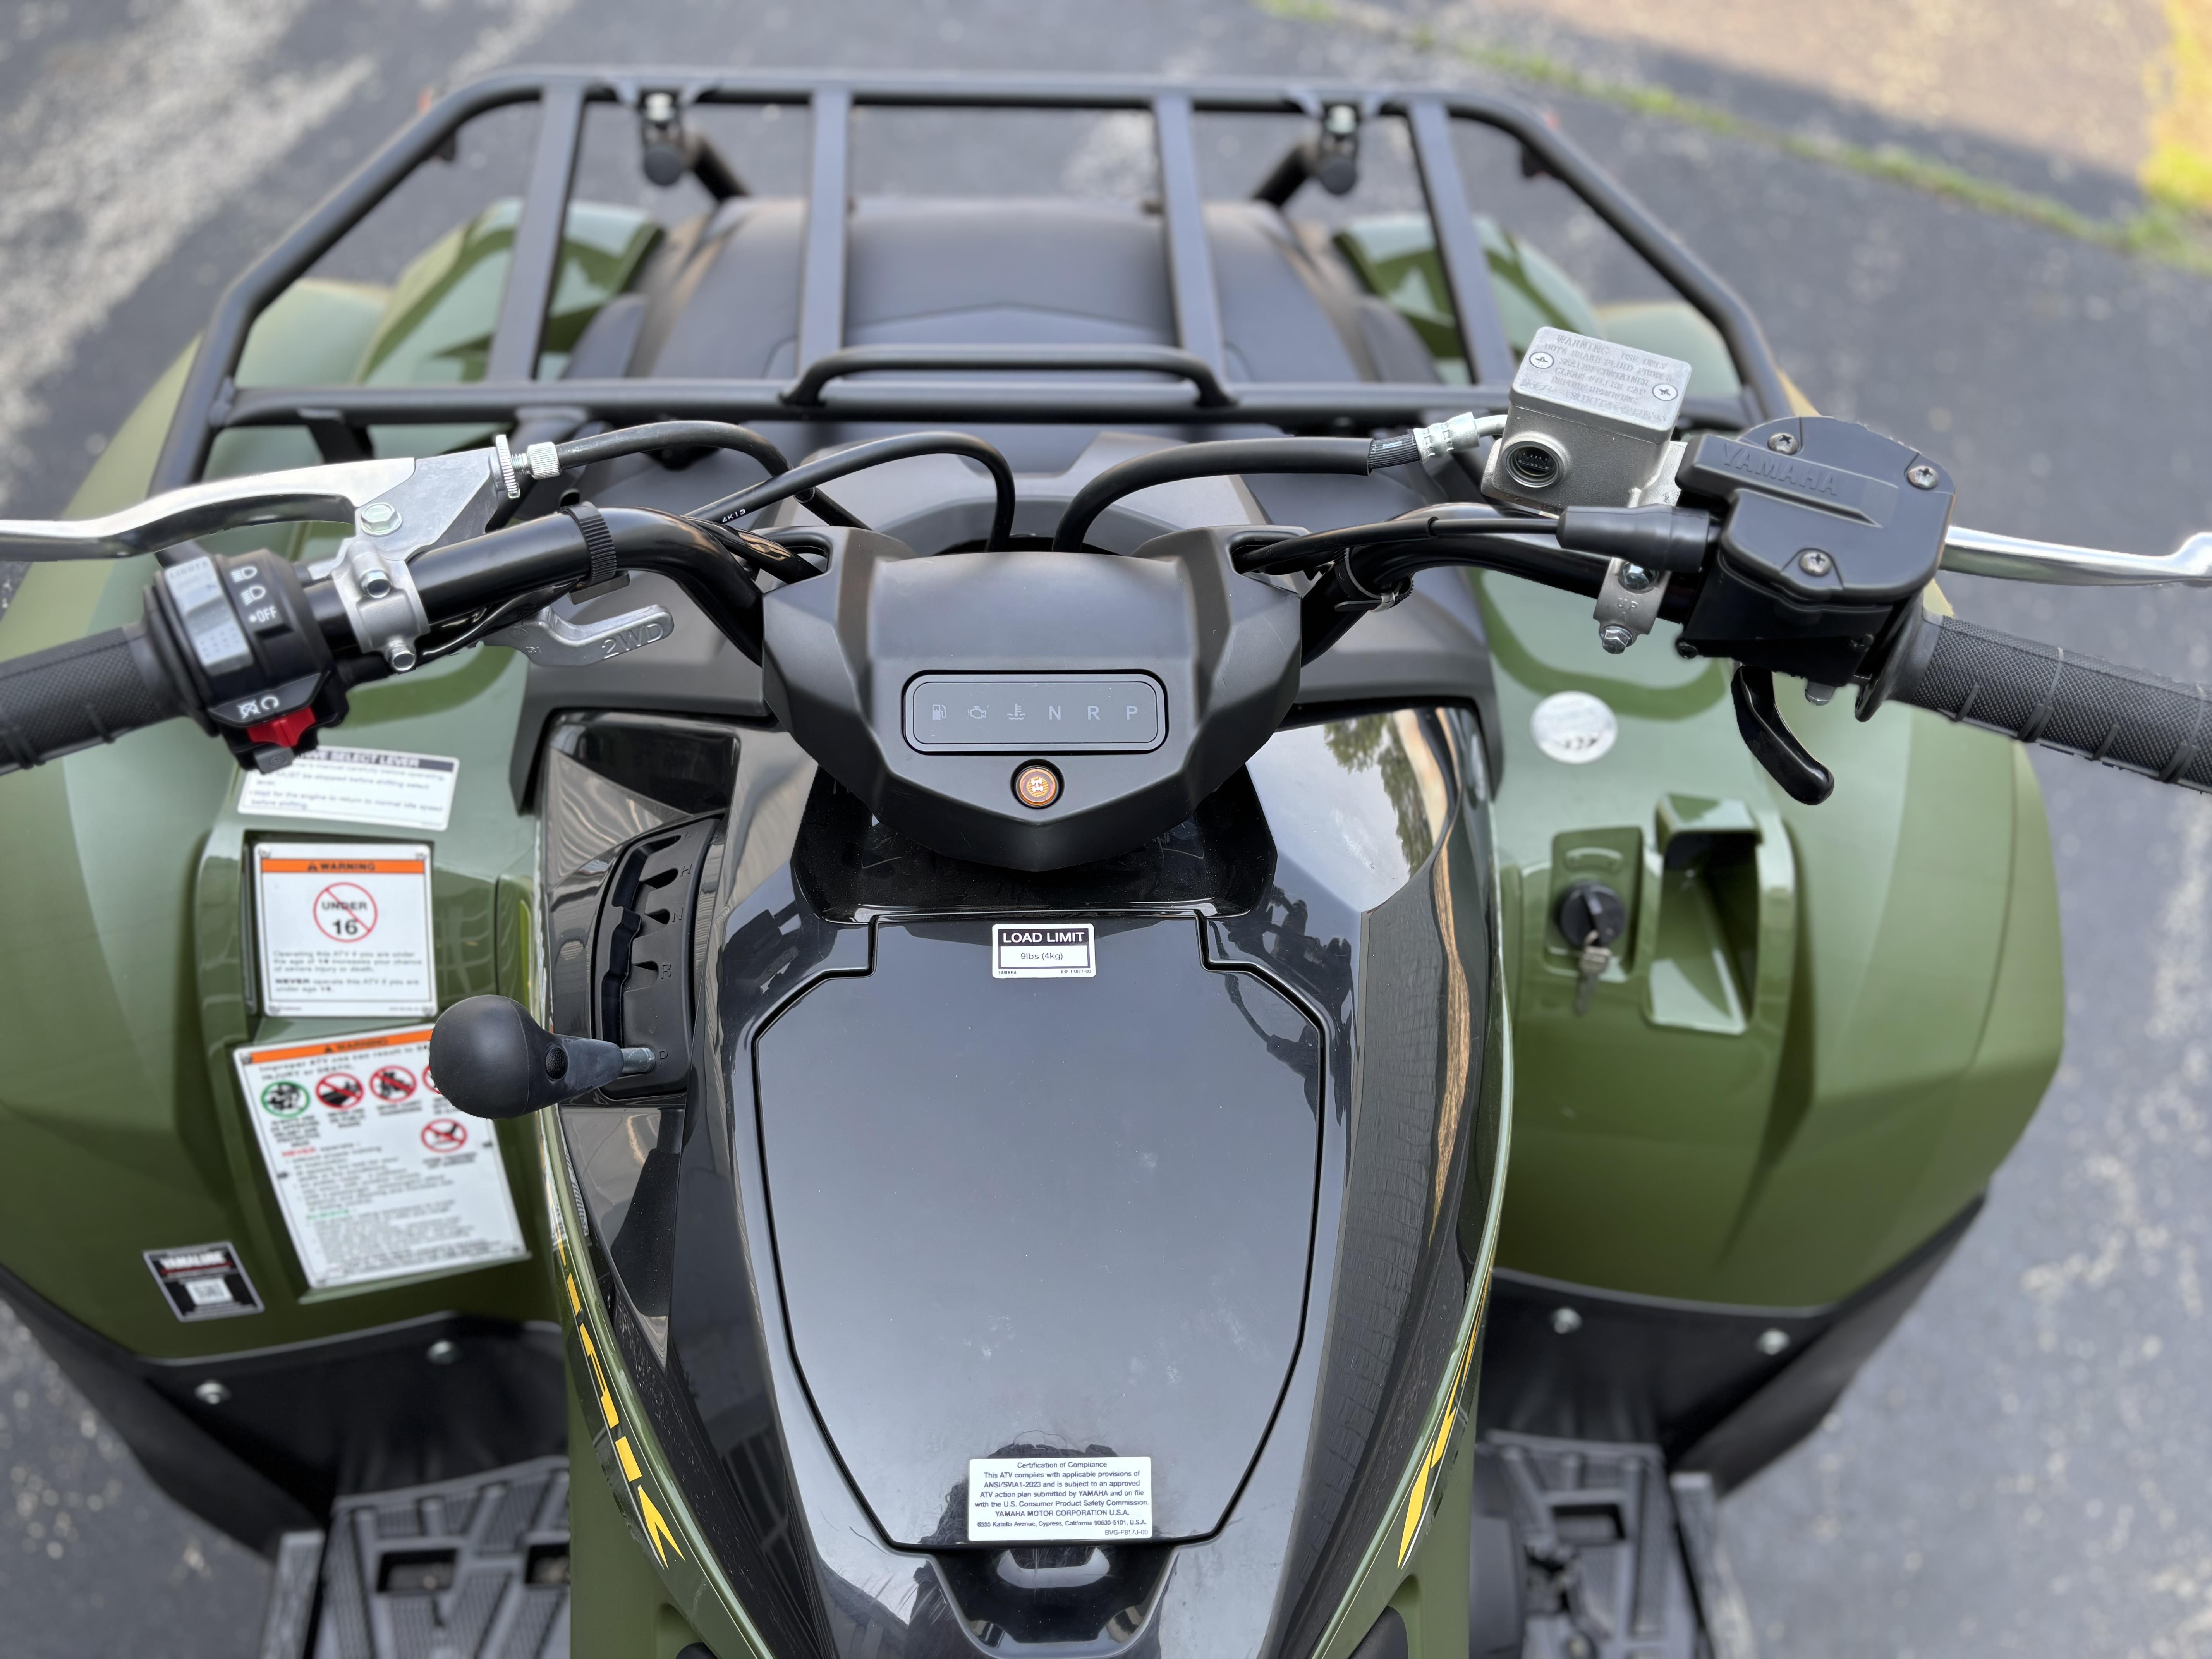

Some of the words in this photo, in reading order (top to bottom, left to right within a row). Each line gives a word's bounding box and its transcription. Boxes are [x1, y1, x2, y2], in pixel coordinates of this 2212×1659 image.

[1557, 335, 1609, 355] WARNING
[1724, 443, 1837, 496] YAMAHA
[170, 561, 209, 579] LIGHTS
[256, 606, 276, 622] OFF
[602, 623, 663, 658] 2WD
[1049, 706, 1061, 720] N
[1087, 706, 1099, 720] R
[1127, 706, 1138, 720] P
[331, 751, 378, 764] SELECT
[380, 754, 419, 768] LEVER
[680, 863, 692, 877] H
[321, 902, 367, 911] UNDER
[672, 910, 683, 923] N
[333, 919, 358, 935] 16
[1003, 933, 1042, 943] LOAD
[1047, 932, 1085, 942] LIMIT
[1042, 952, 1063, 960] (4kg)
[660, 964, 671, 979] R
[659, 1051, 668, 1066] P
